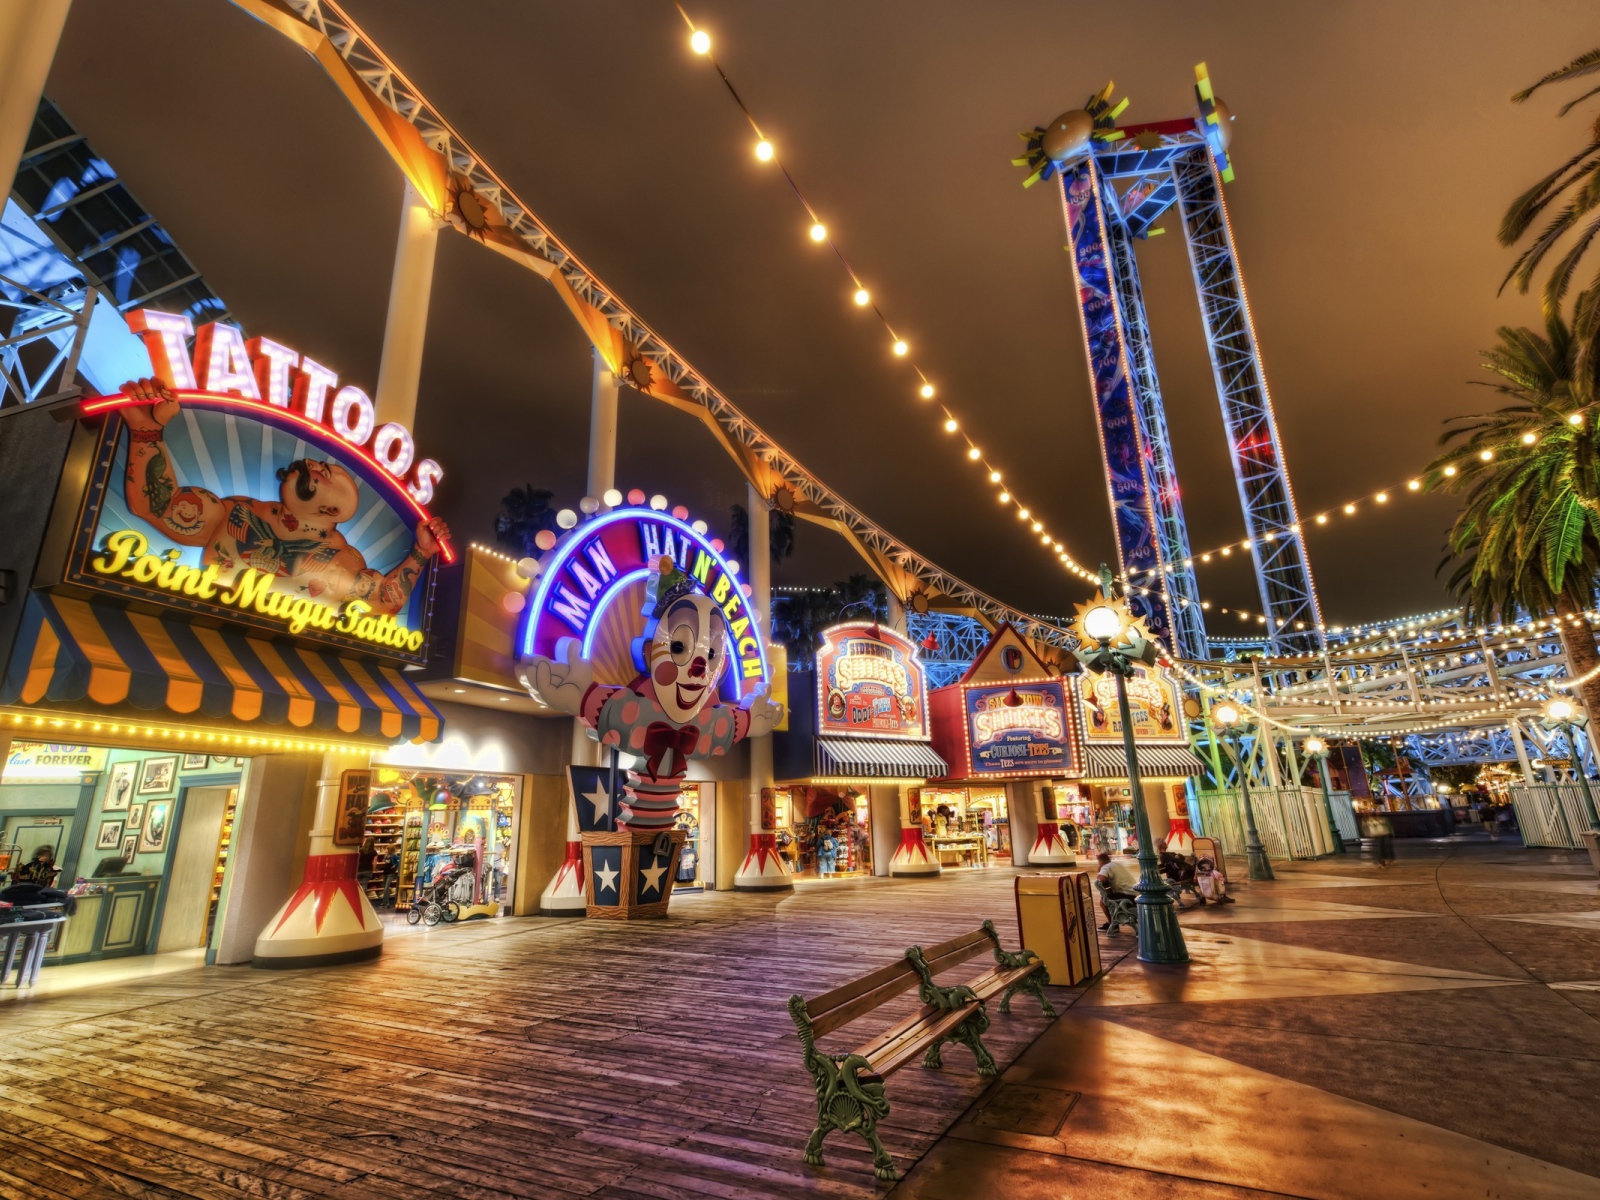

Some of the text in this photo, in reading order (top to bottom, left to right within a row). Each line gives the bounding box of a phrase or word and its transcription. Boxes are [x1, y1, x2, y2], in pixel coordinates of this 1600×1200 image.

[1079, 242, 1099, 257] 900
[1087, 298, 1108, 312] 800
[125, 308, 444, 506] TATTOOS
[1107, 415, 1128, 429] 600
[1116, 479, 1138, 494] 500
[1128, 545, 1150, 559] 400
[92, 529, 424, 652] Point Mugu Tattoo
[550, 536, 617, 633] MAN
[640, 522, 692, 571] HAT
[712, 574, 763, 680] BEACH
[976, 707, 1062, 742] SHIRTS
[35, 754, 92, 765] FOREVER
[1000, 759, 1015, 768] TEES
